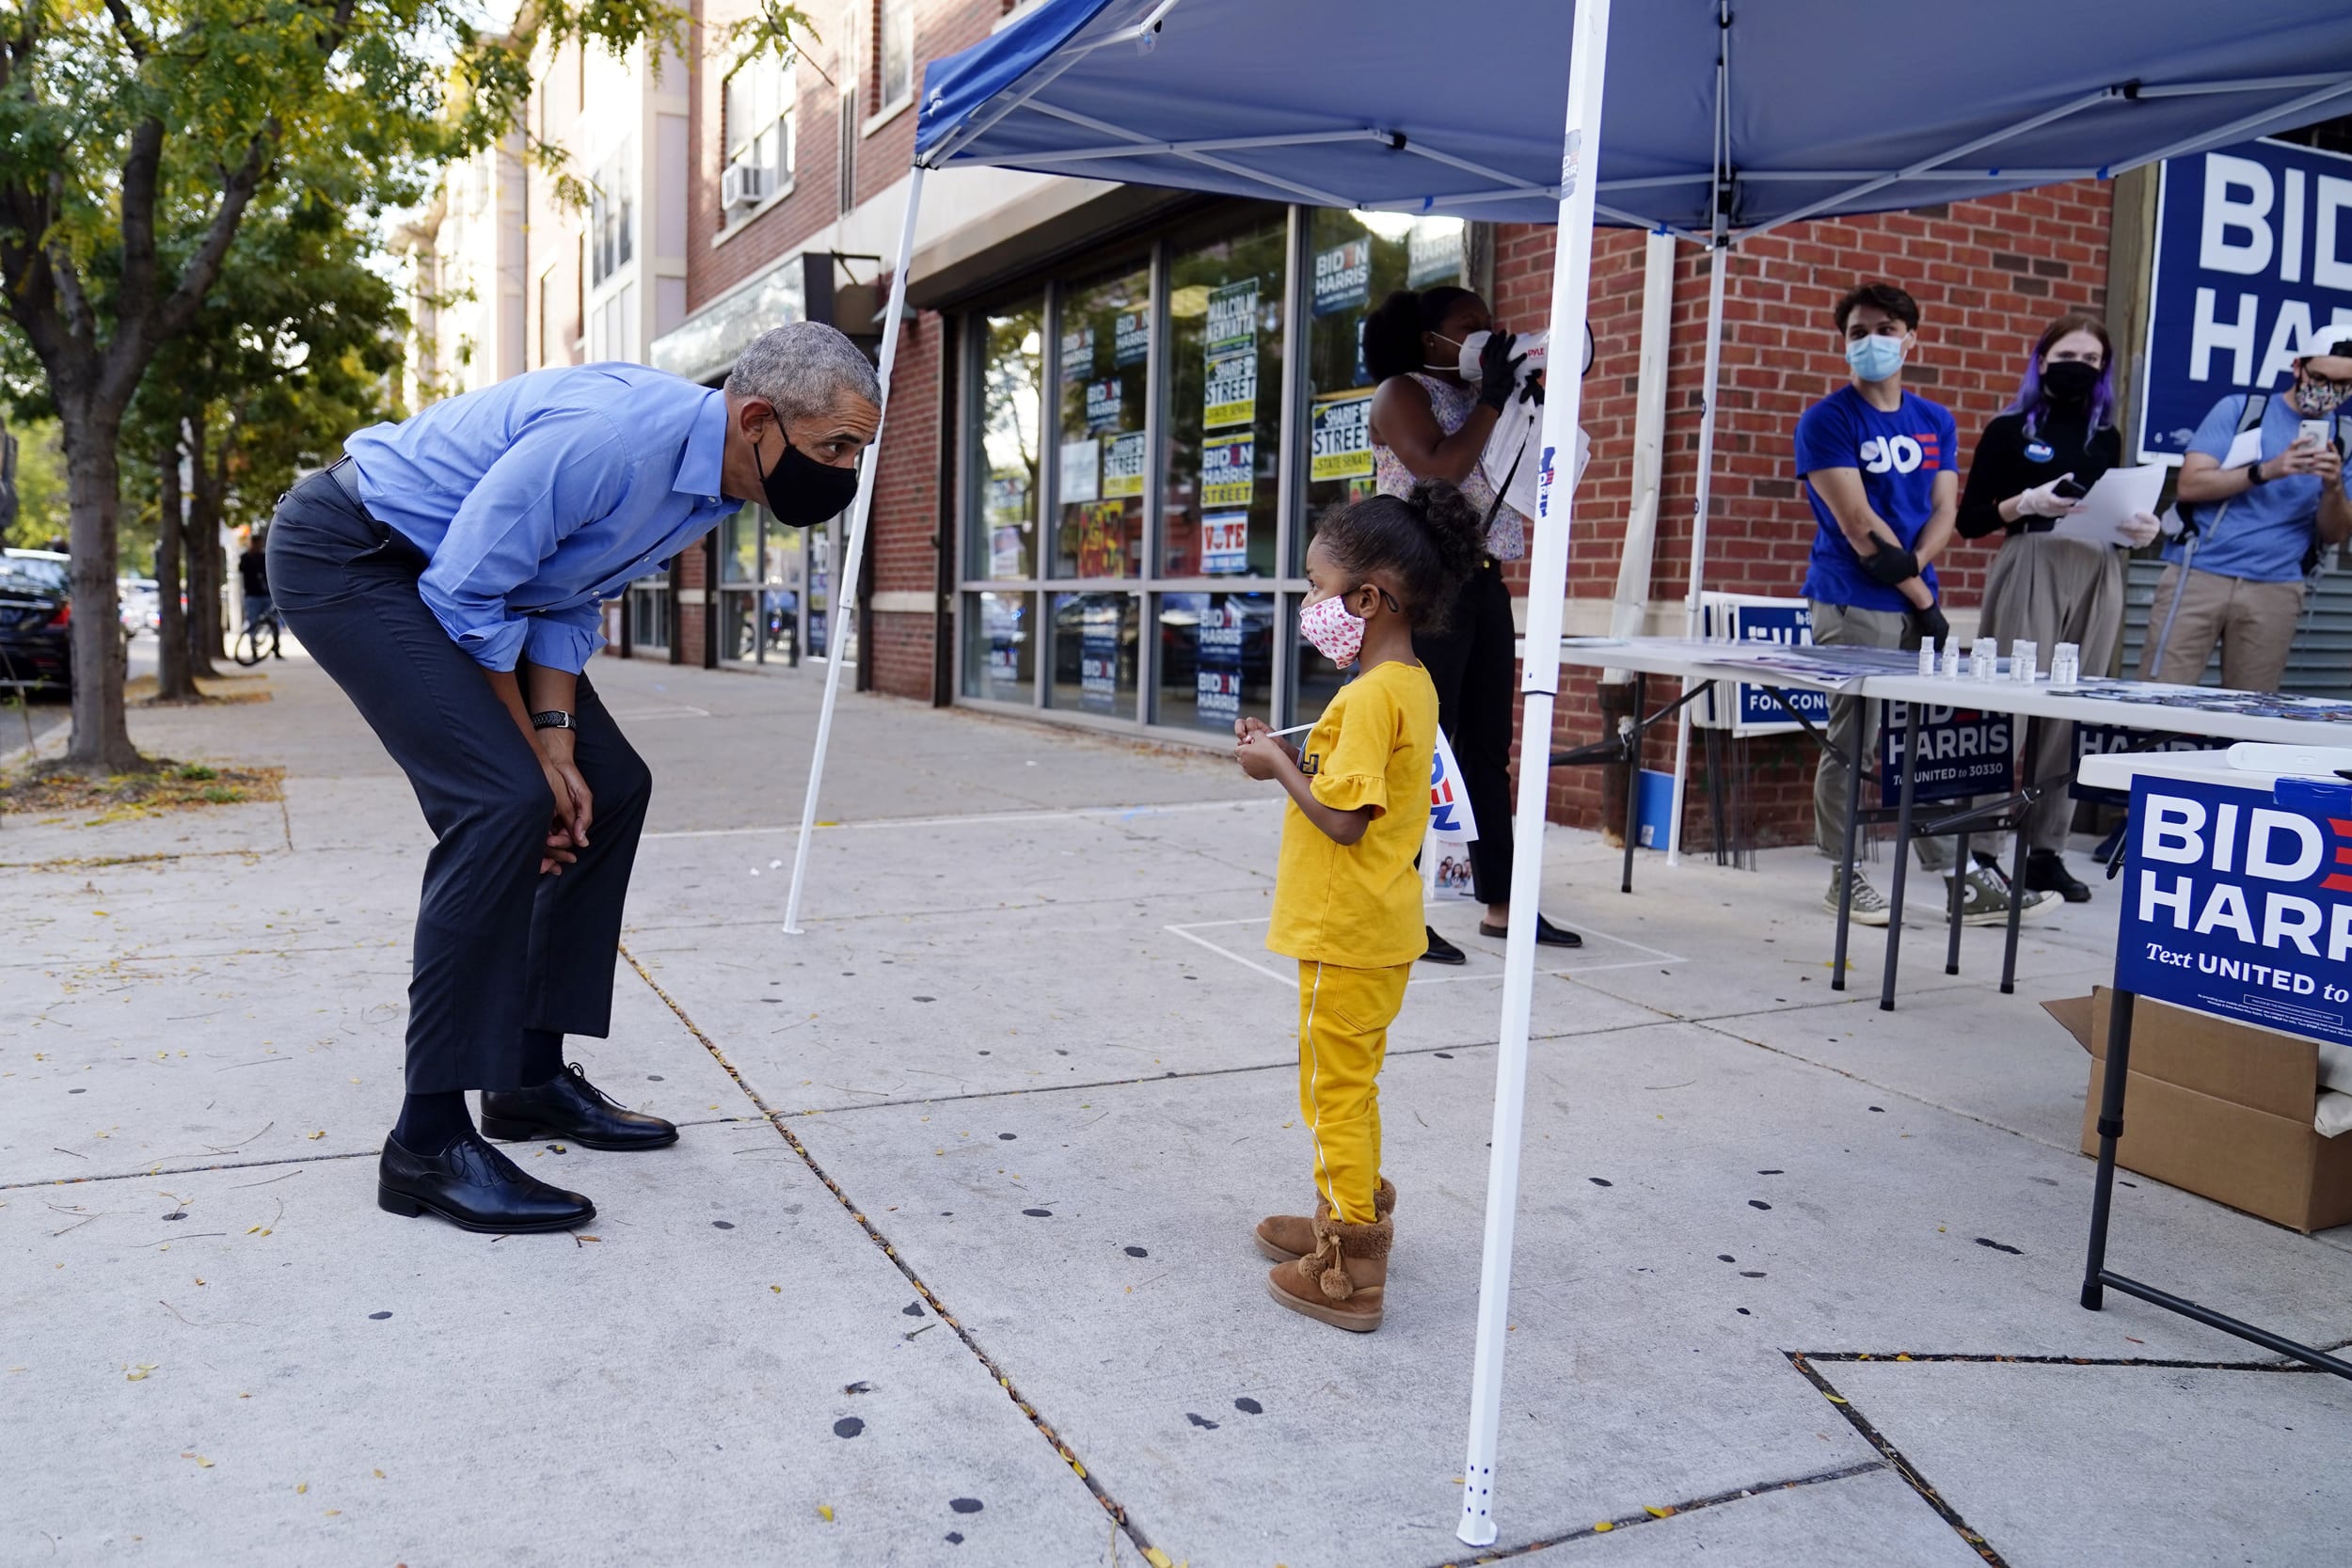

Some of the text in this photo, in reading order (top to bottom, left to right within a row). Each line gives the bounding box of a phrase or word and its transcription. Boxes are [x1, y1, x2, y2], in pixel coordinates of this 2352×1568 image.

[1316, 243, 1368, 277] BIDEN
[1315, 265, 1368, 295] HARRIS
[1528, 348, 1545, 357] PYLE
[1088, 380, 1121, 404] BIDEN
[1204, 377, 1254, 404] STREET
[1325, 406, 1359, 425] SHARIF
[1204, 444, 1252, 468] BIDEN
[1203, 467, 1251, 485] HARRIS
[1202, 487, 1249, 503] STREET
[1205, 523, 1245, 549] VOTE
[1200, 609, 1242, 628] BIDEN
[1200, 628, 1242, 645] HARRIS
[1082, 659, 1116, 677] BIDEN
[1198, 673, 1240, 694] BIDEN
[1198, 692, 1240, 713] HARRIS
[1889, 723, 2009, 765] HARRIS
[1914, 768, 1957, 783] UNITED
[1969, 763, 2003, 777] 30330
[2146, 942, 2349, 1003] Text UNITED to
